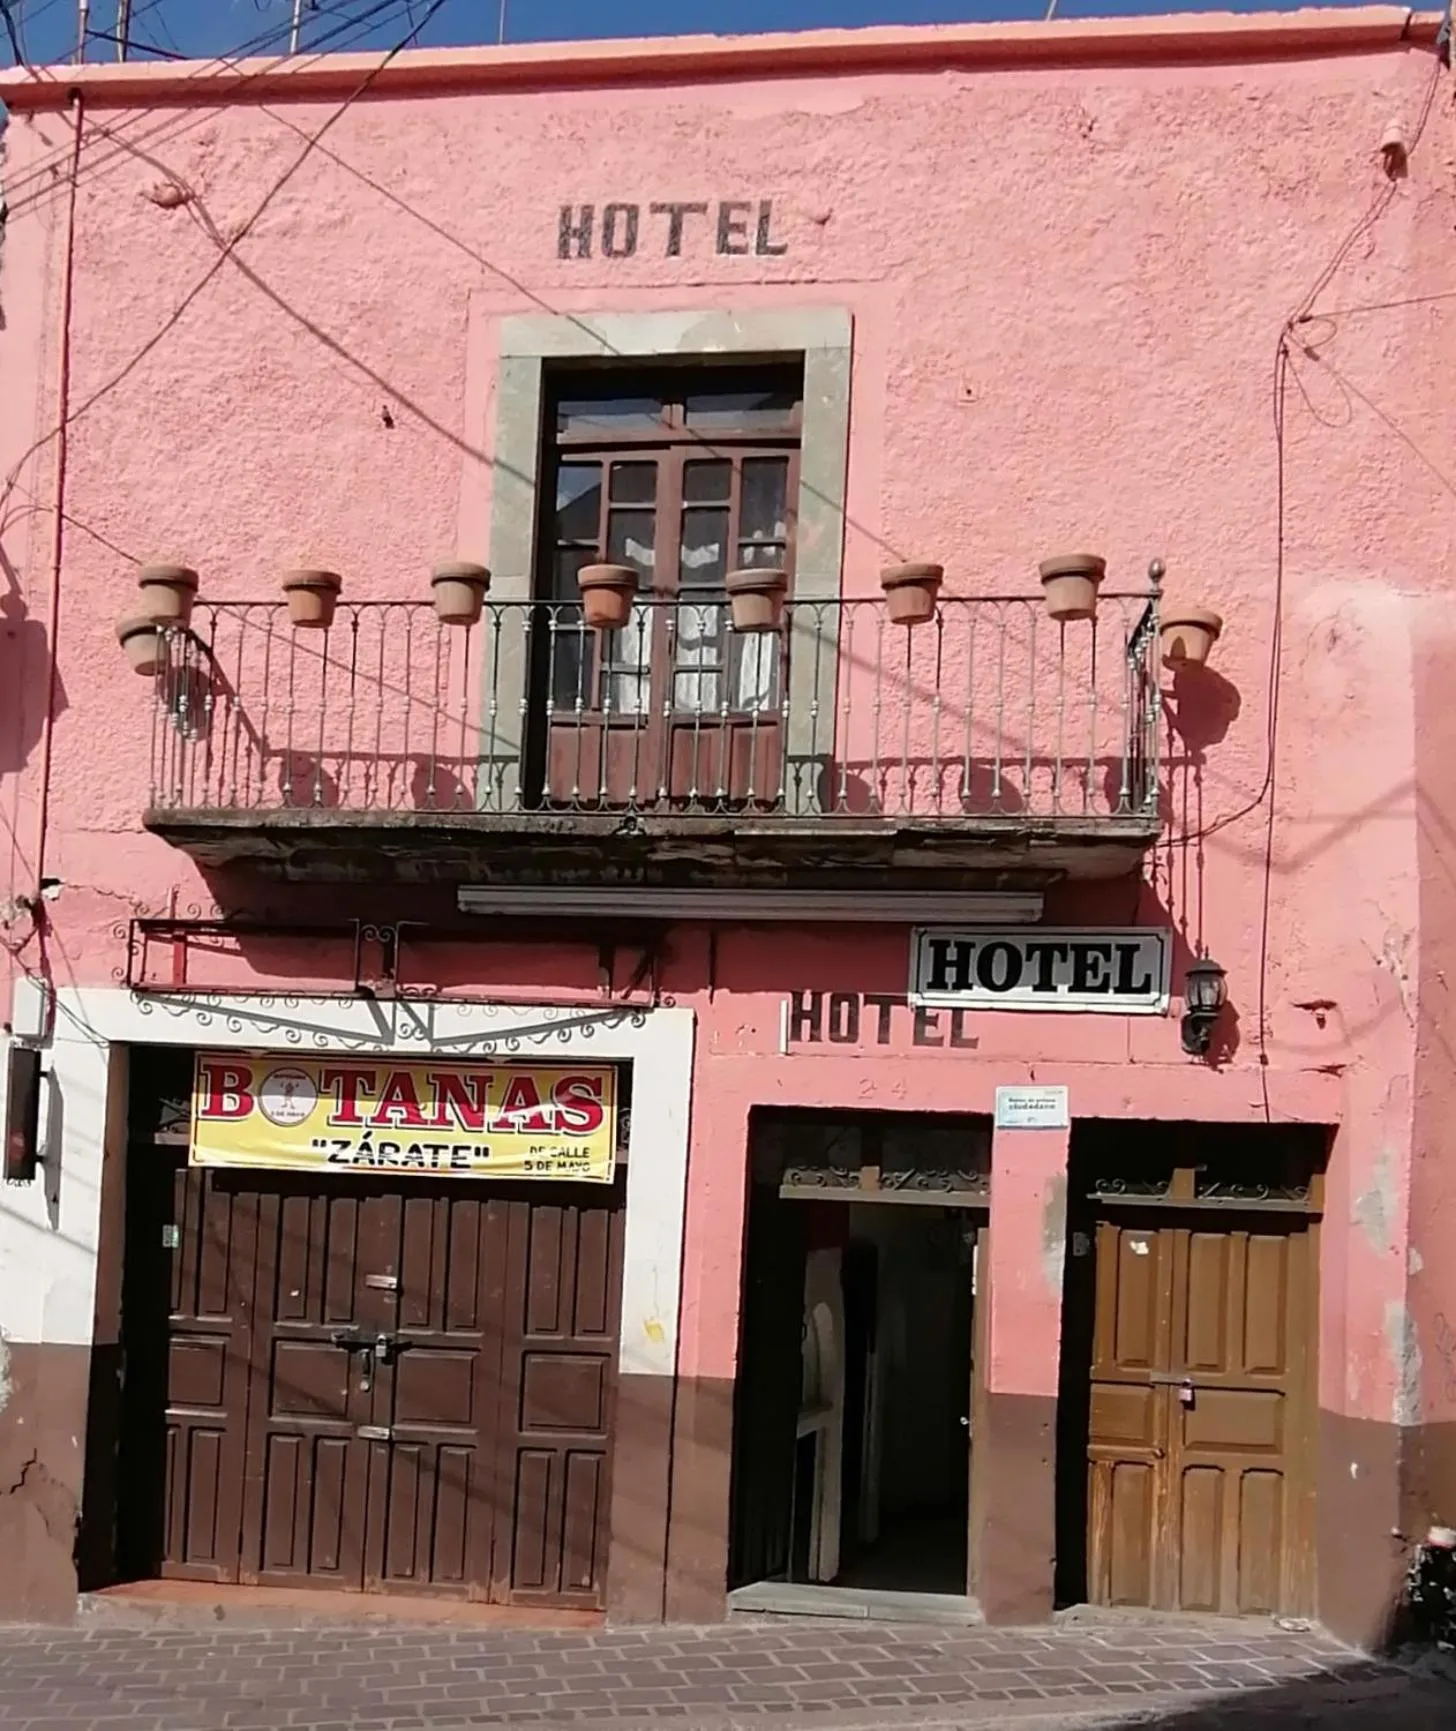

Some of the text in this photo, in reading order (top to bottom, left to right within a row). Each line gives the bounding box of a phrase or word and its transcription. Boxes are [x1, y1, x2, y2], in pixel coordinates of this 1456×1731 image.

[557, 199, 789, 259] HOTEL
[926, 939, 1151, 994] HOTEL
[790, 990, 980, 1049] HOTEL
[524, 1160, 533, 1171] 5
[536, 1160, 553, 1171] DE
[550, 1147, 591, 1158] CALLE
